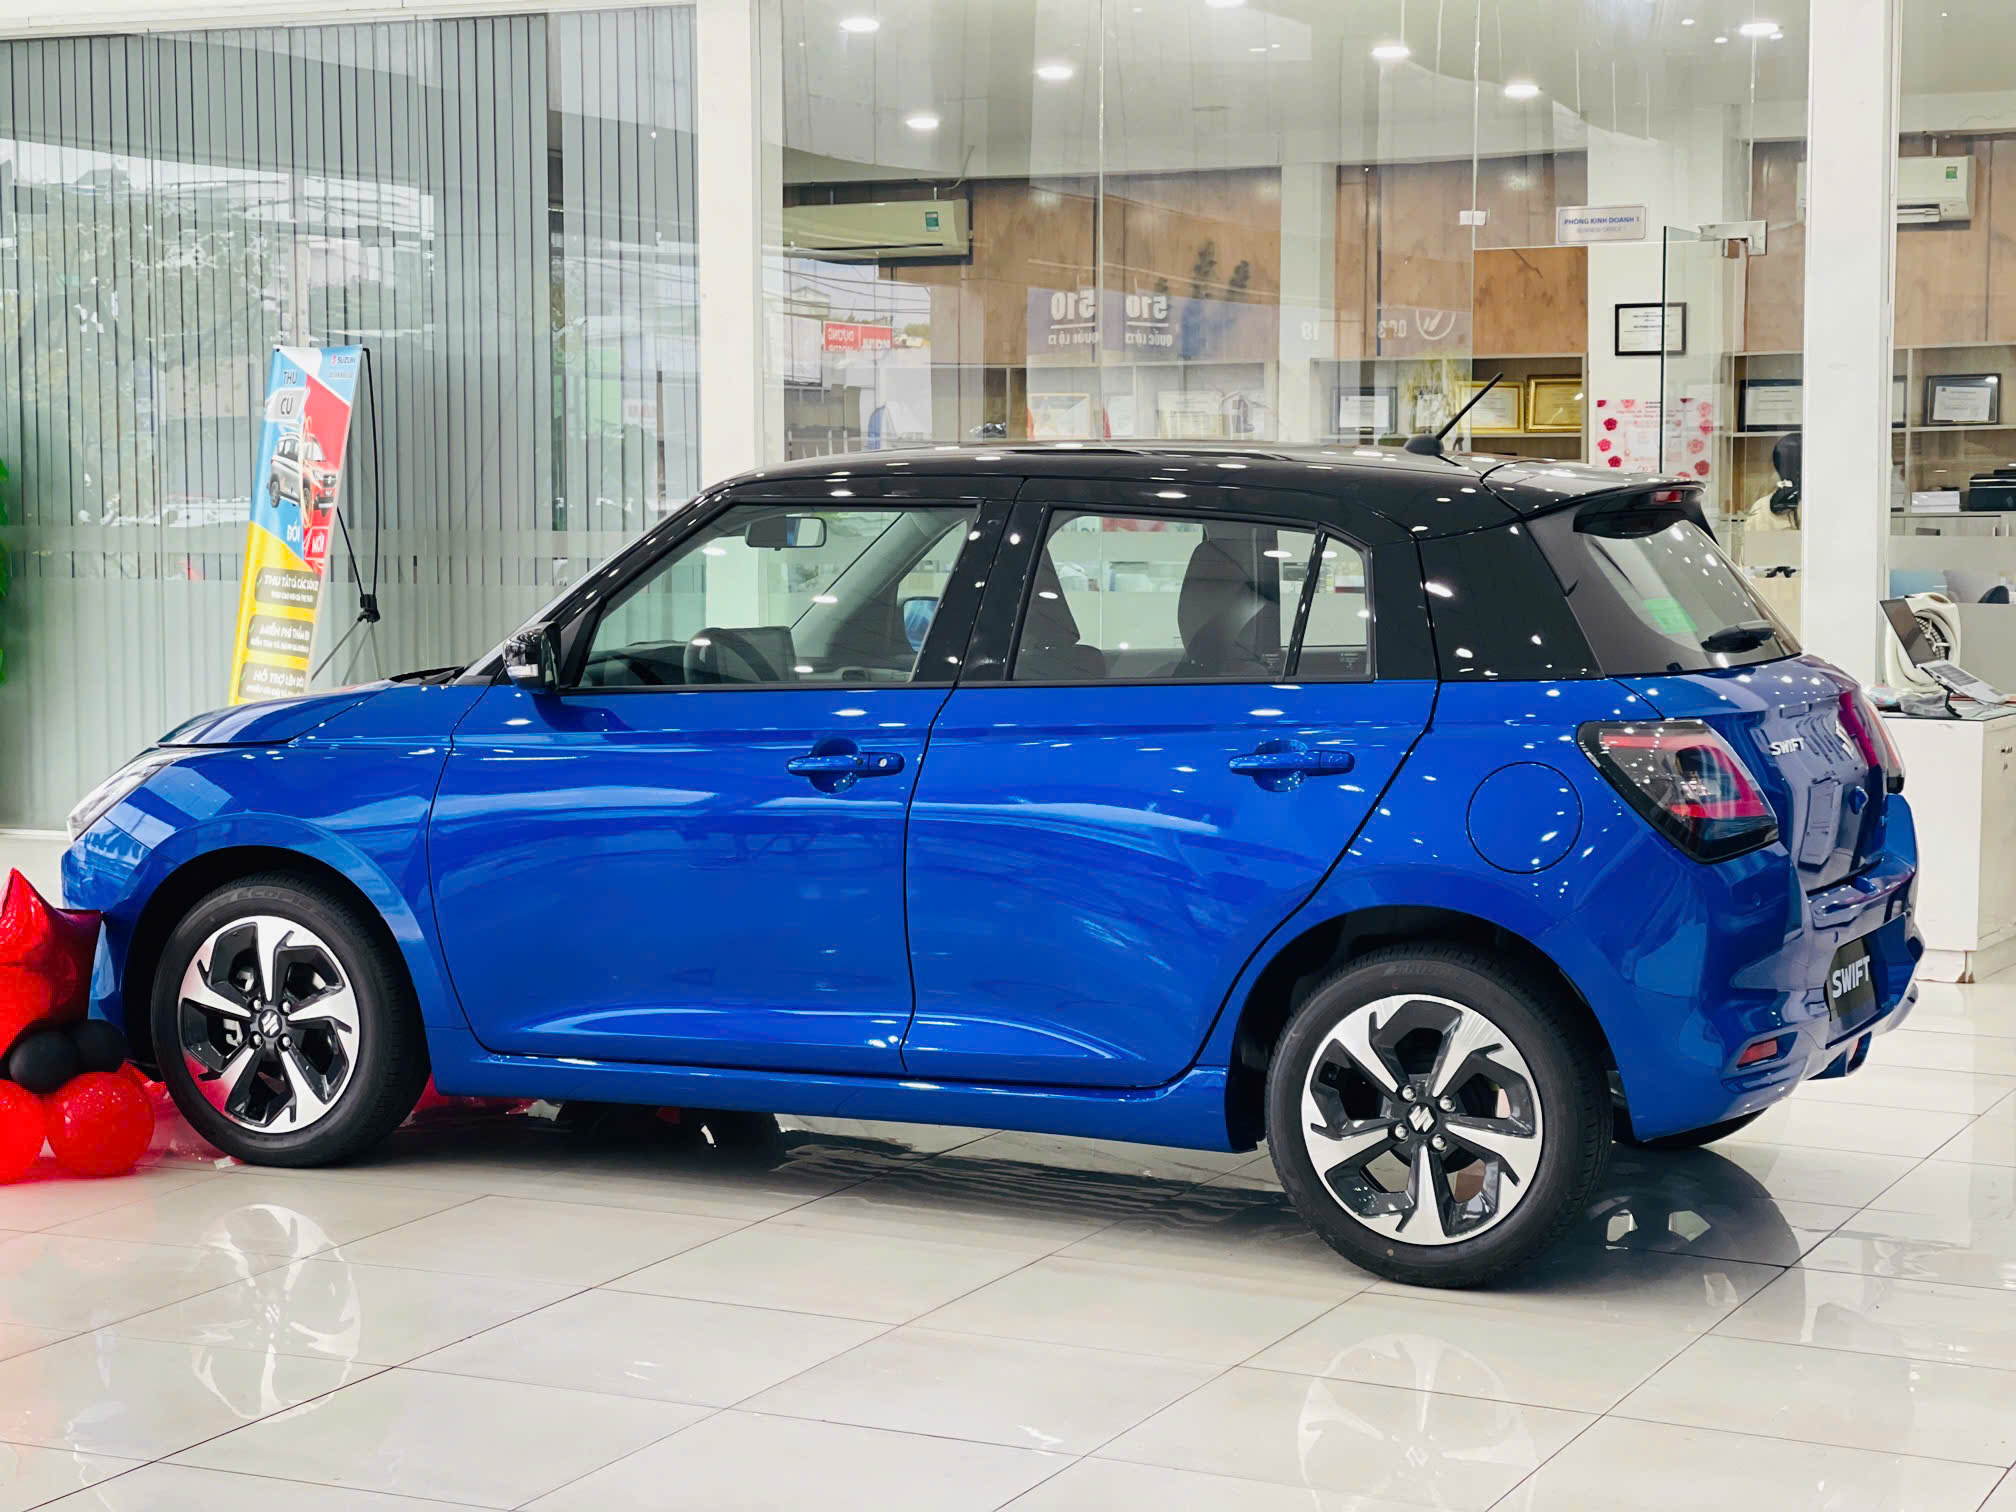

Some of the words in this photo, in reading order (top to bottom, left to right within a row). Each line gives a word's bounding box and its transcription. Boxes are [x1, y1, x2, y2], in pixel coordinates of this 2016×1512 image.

[1608, 216, 1635, 224] DOANH
[283, 371, 297, 384] THU
[1769, 737, 1804, 756] SWIFT
[1832, 955, 1870, 999] SWIFT
